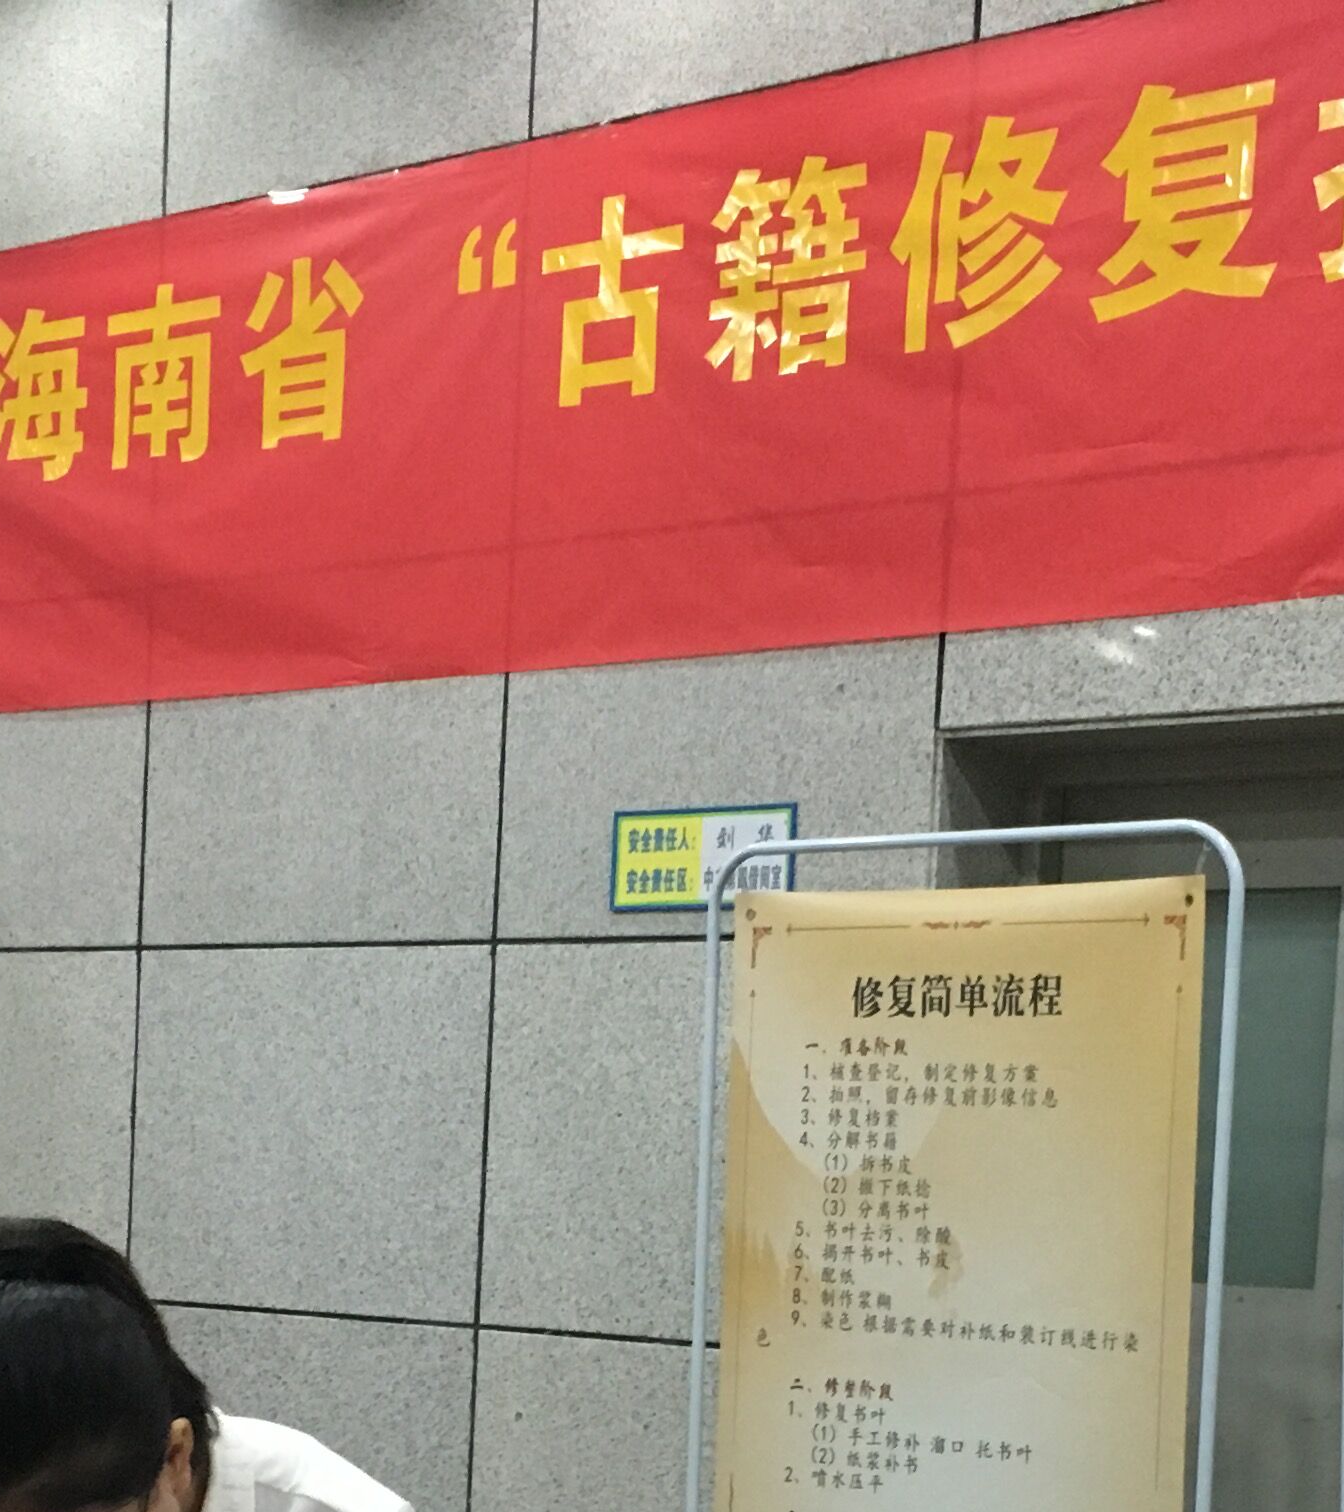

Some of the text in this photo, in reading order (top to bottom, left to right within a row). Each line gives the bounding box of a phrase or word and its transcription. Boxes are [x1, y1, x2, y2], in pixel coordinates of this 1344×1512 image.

[851, 973, 1063, 1019] 修复简单流程
